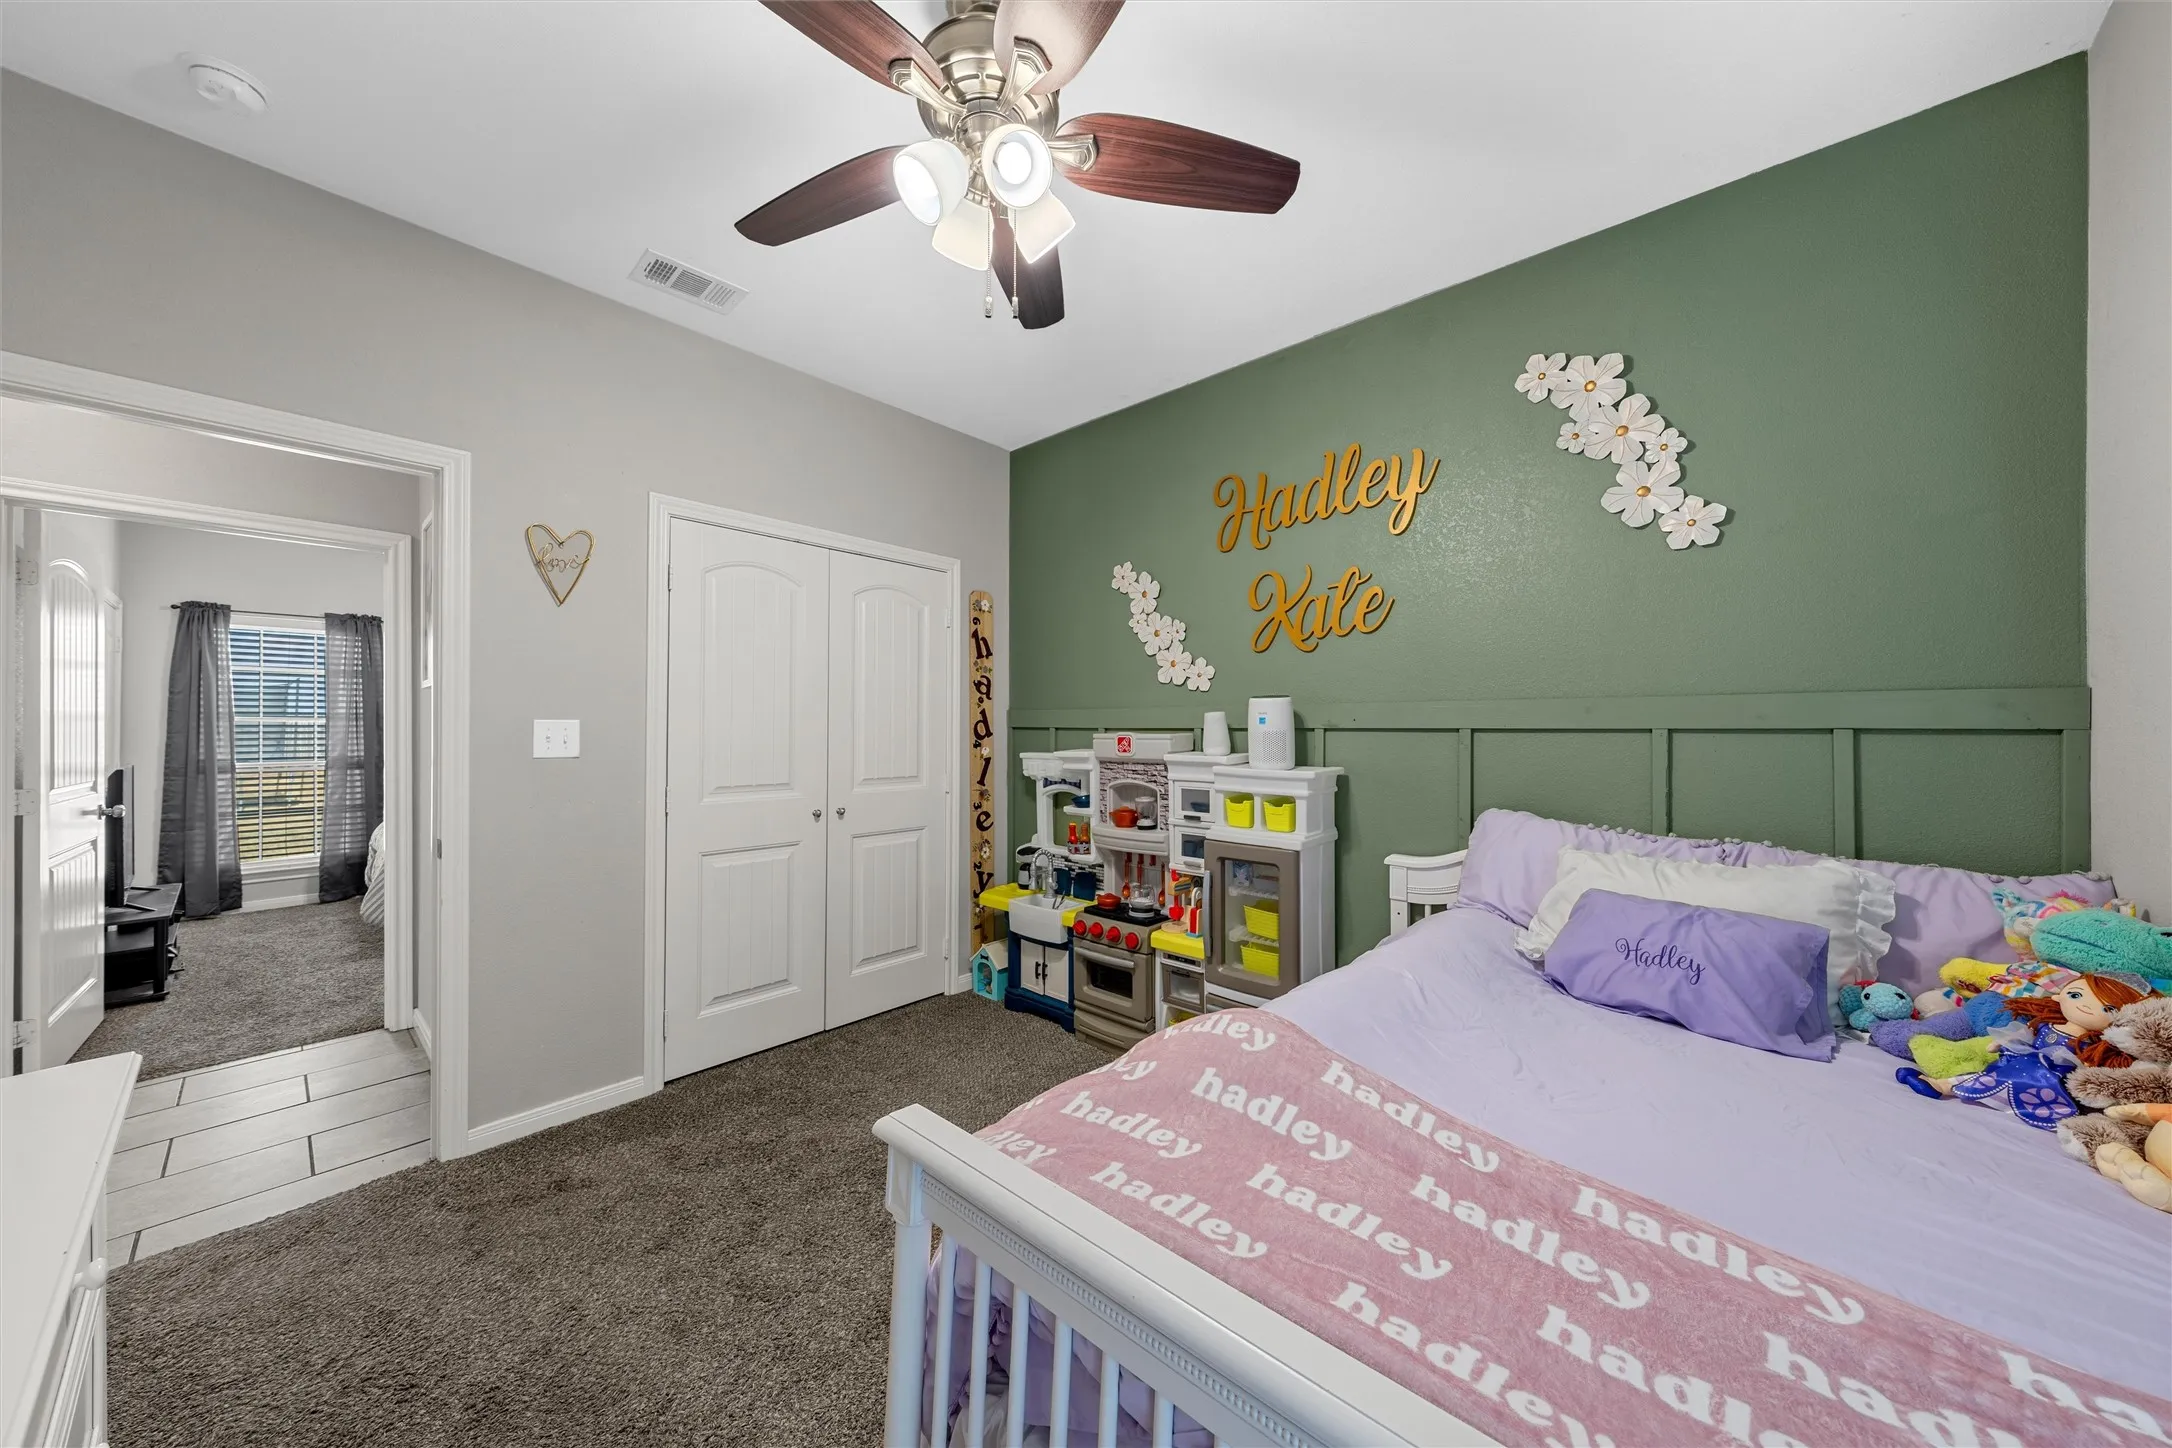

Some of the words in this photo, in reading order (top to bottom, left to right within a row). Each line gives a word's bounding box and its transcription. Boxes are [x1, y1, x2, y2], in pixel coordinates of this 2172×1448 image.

[1213, 442, 1440, 552] Hadley
[1248, 564, 1395, 653] Kate
[1615, 937, 1706, 985] Hadley
[1060, 1091, 1202, 1158] hadley
[1191, 1066, 1352, 1162] hadley
[1320, 1060, 1500, 1173] hadley
[1089, 1161, 1268, 1260] hadley
[1245, 1163, 1453, 1281] hadley
[1410, 1173, 1650, 1310] hadley
[1572, 1185, 1866, 1326] hadley
